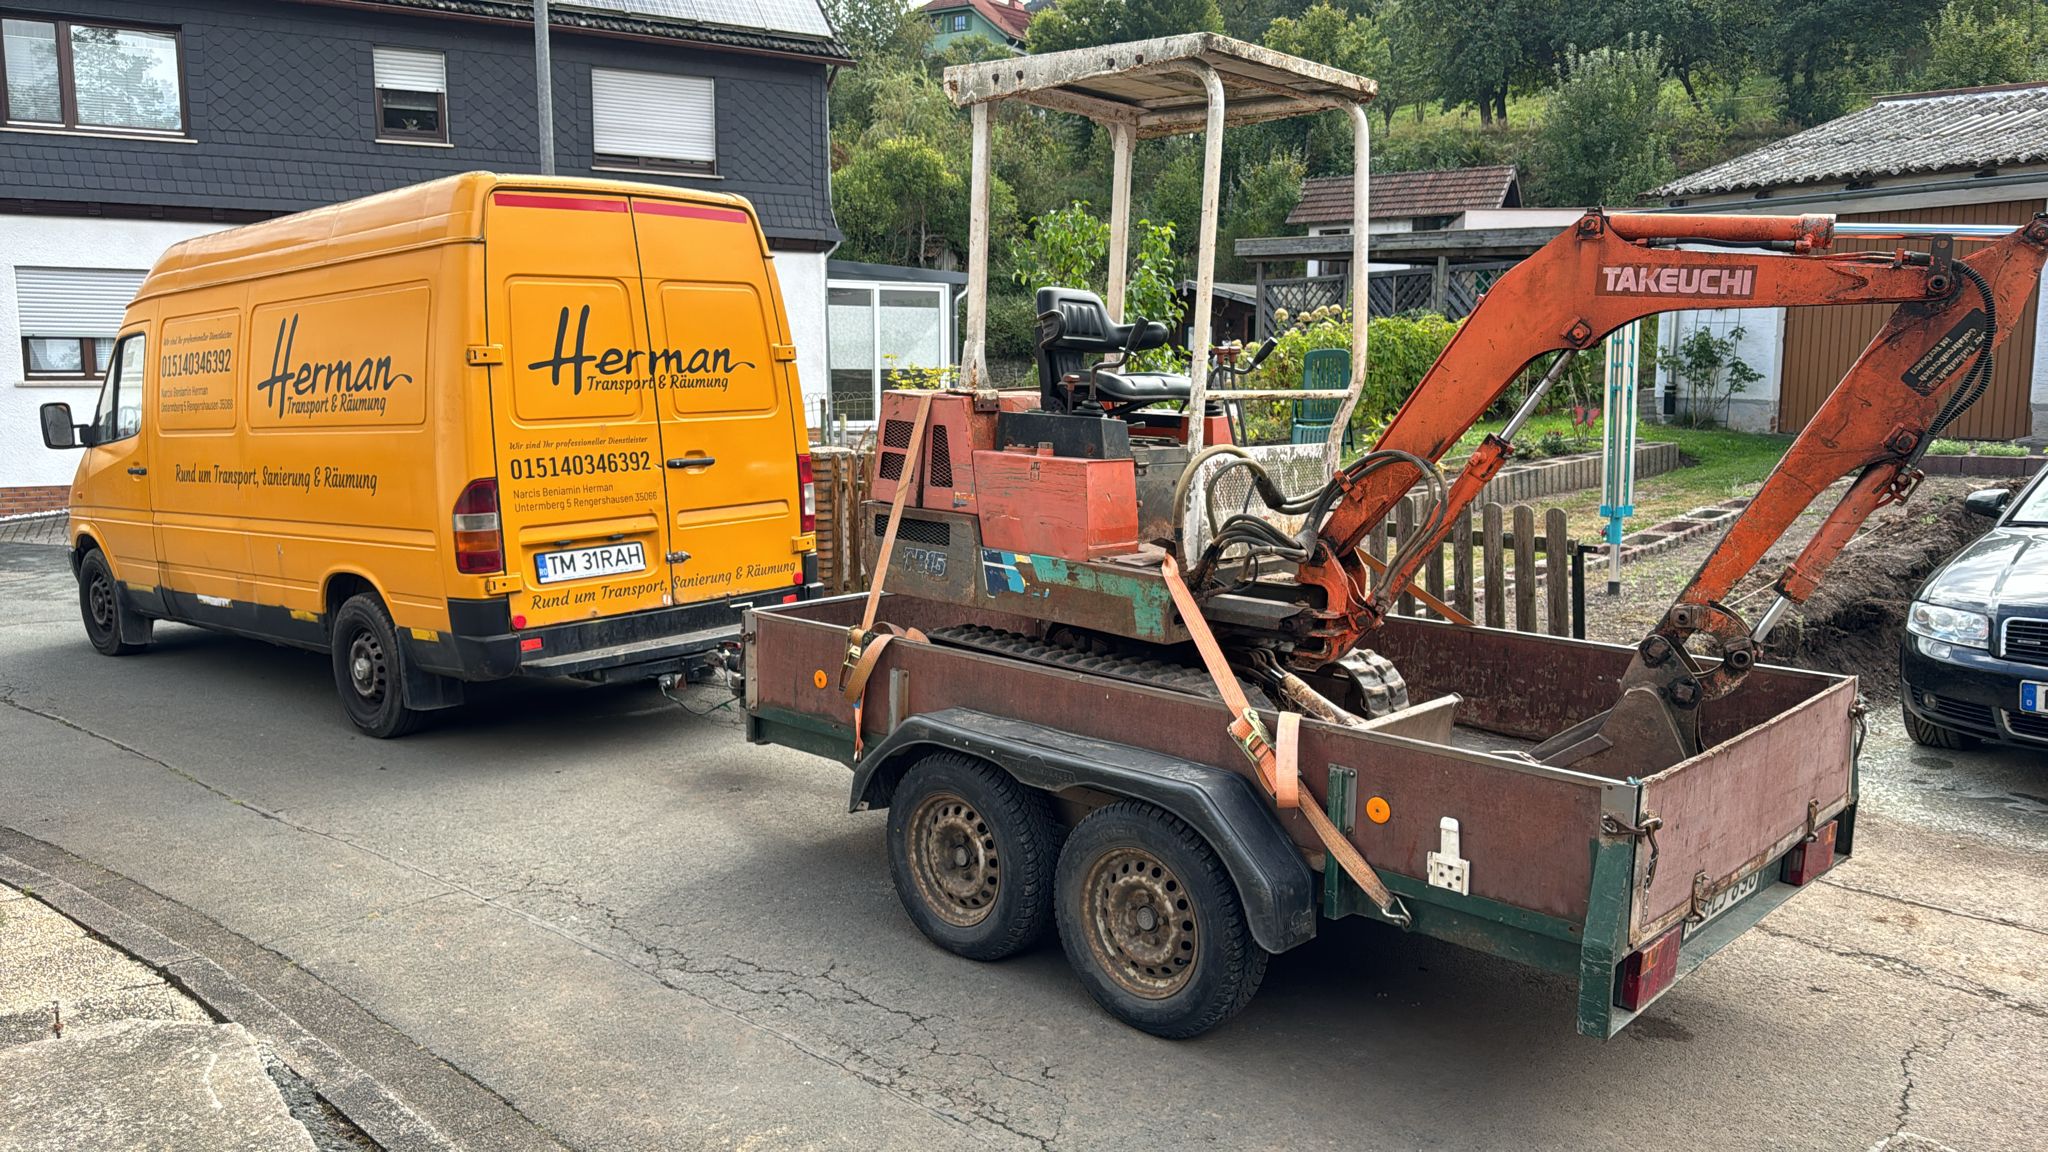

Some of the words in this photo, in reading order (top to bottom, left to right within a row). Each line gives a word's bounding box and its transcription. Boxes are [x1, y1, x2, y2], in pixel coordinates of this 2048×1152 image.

[1602, 266, 1753, 296] TAKEUCHI
[161, 348, 232, 378] 015140346392
[528, 304, 756, 396] Herman
[257, 313, 413, 420] Herman
[587, 375, 654, 395] Transport
[658, 375, 667, 390] &
[670, 374, 729, 392] Räumung
[287, 397, 329, 419] Transport
[331, 394, 338, 412] &
[339, 393, 387, 417] Räumung
[509, 441, 524, 450] Wir
[525, 440, 541, 450] sind
[555, 437, 606, 450] professioneller
[608, 435, 648, 445] Dienstleister
[175, 463, 197, 483] Rund
[198, 469, 212, 484] um
[213, 464, 259, 490] Transport,
[262, 465, 311, 494] Sanierung
[314, 466, 321, 487] &
[323, 466, 378, 497] Räumung
[510, 450, 652, 480] 015140346392
[513, 487, 541, 499] Narcis
[542, 485, 581, 497] Beniamin
[582, 483, 614, 494] Herman
[514, 500, 565, 513] Untermberg
[566, 498, 572, 508] 5
[573, 495, 634, 508] Rengershausen
[635, 491, 658, 502] 35066
[548, 553, 577, 575] TM
[531, 590, 571, 610] Rund
[574, 591, 596, 601] um
[600, 580, 668, 600] Transport,
[673, 573, 732, 589] Sanierung
[735, 566, 743, 580] &
[746, 561, 796, 578] Räumung
